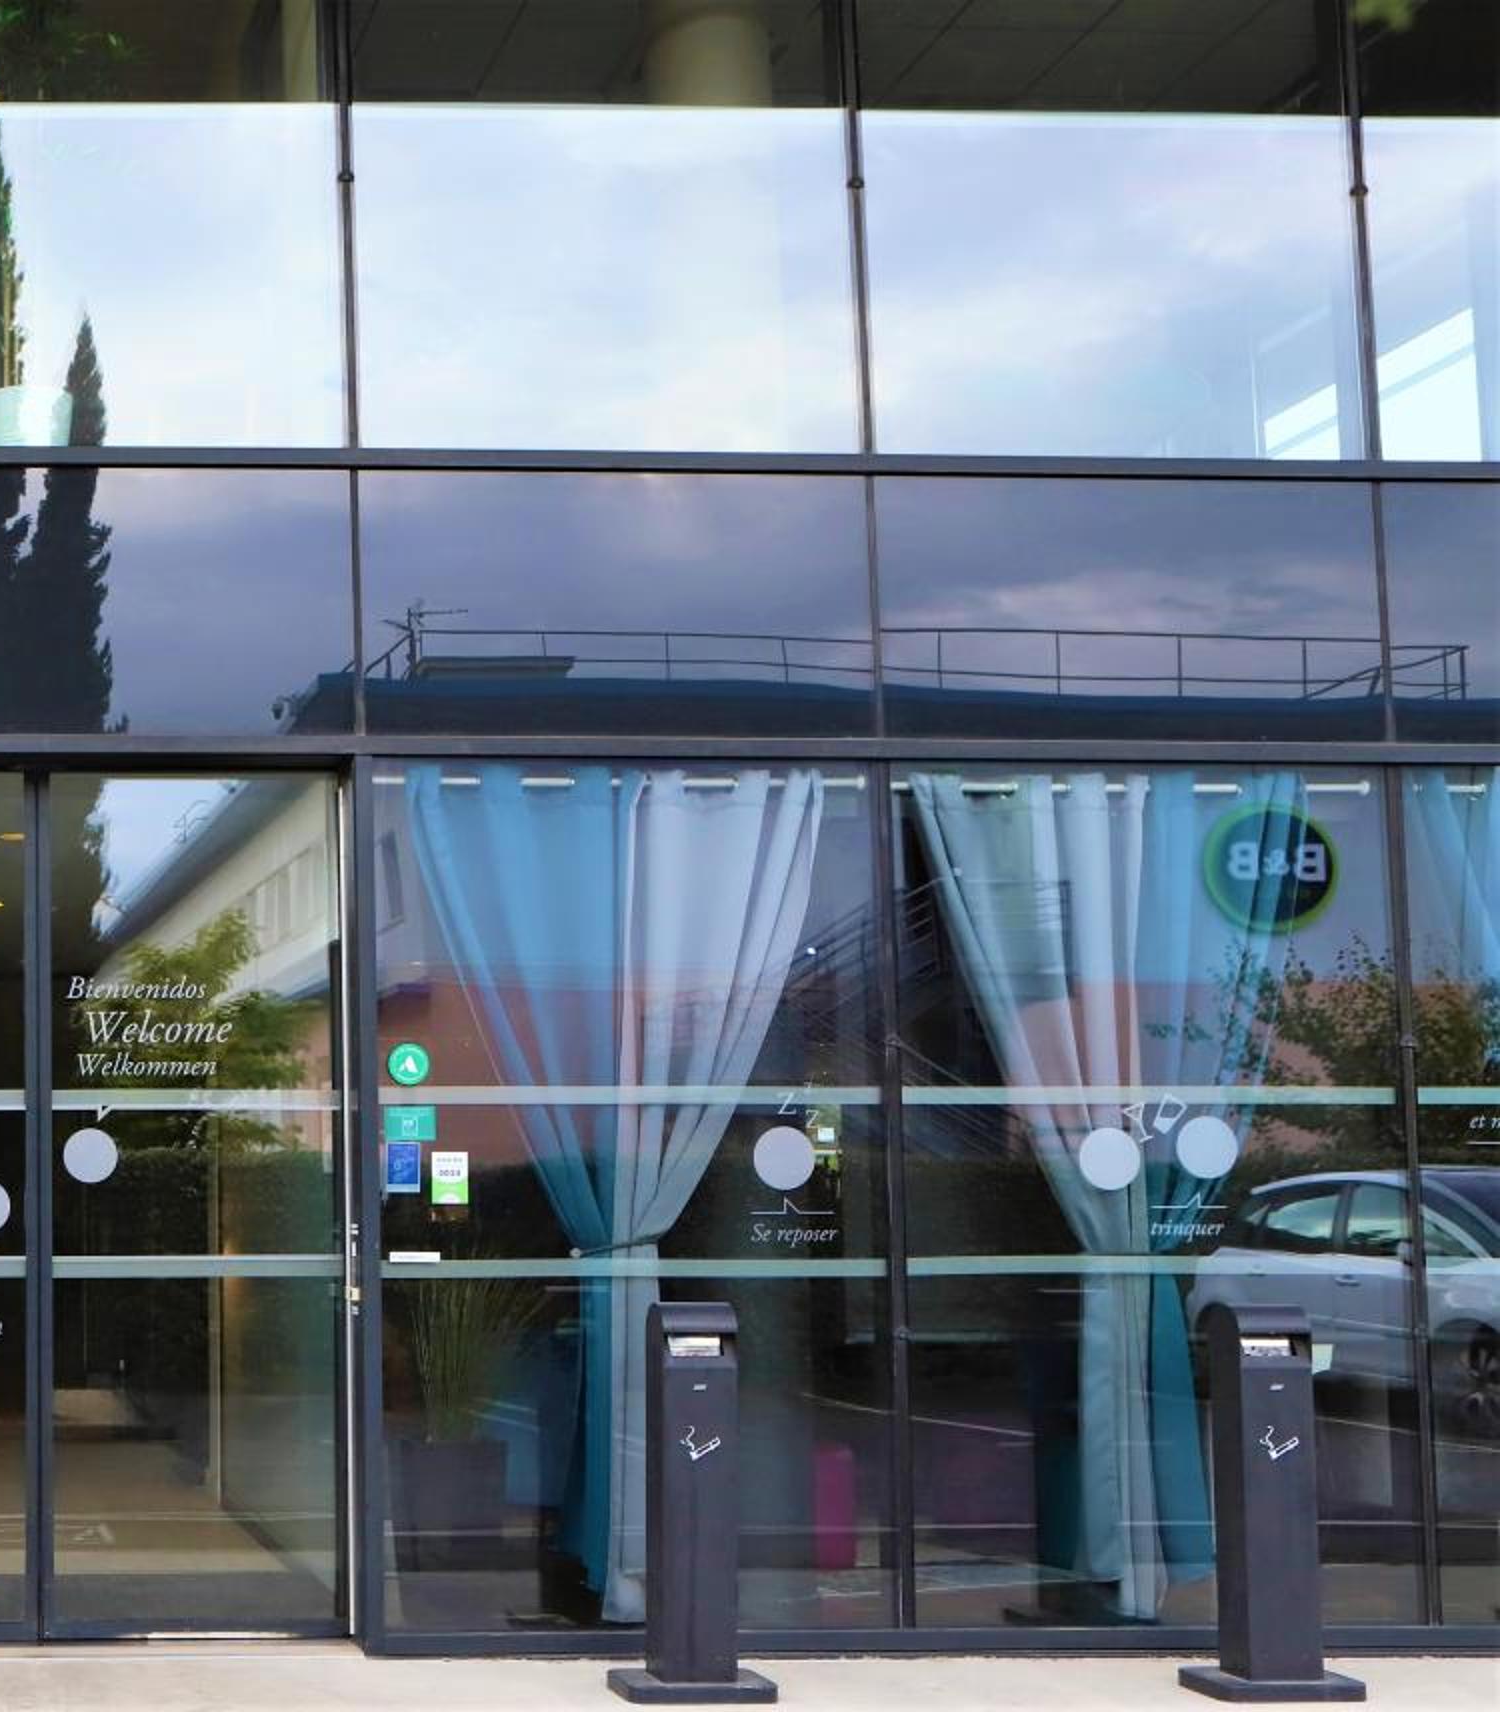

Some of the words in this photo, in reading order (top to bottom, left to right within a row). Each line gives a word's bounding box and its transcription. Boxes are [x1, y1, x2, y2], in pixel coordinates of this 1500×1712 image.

[67, 975, 207, 999] Bienvenidos
[86, 1009, 233, 1044] Welcome
[77, 1052, 217, 1076] Welkommen
[751, 1223, 773, 1242] Se
[777, 1228, 839, 1248] reposer
[1150, 1220, 1225, 1242] trinquer
